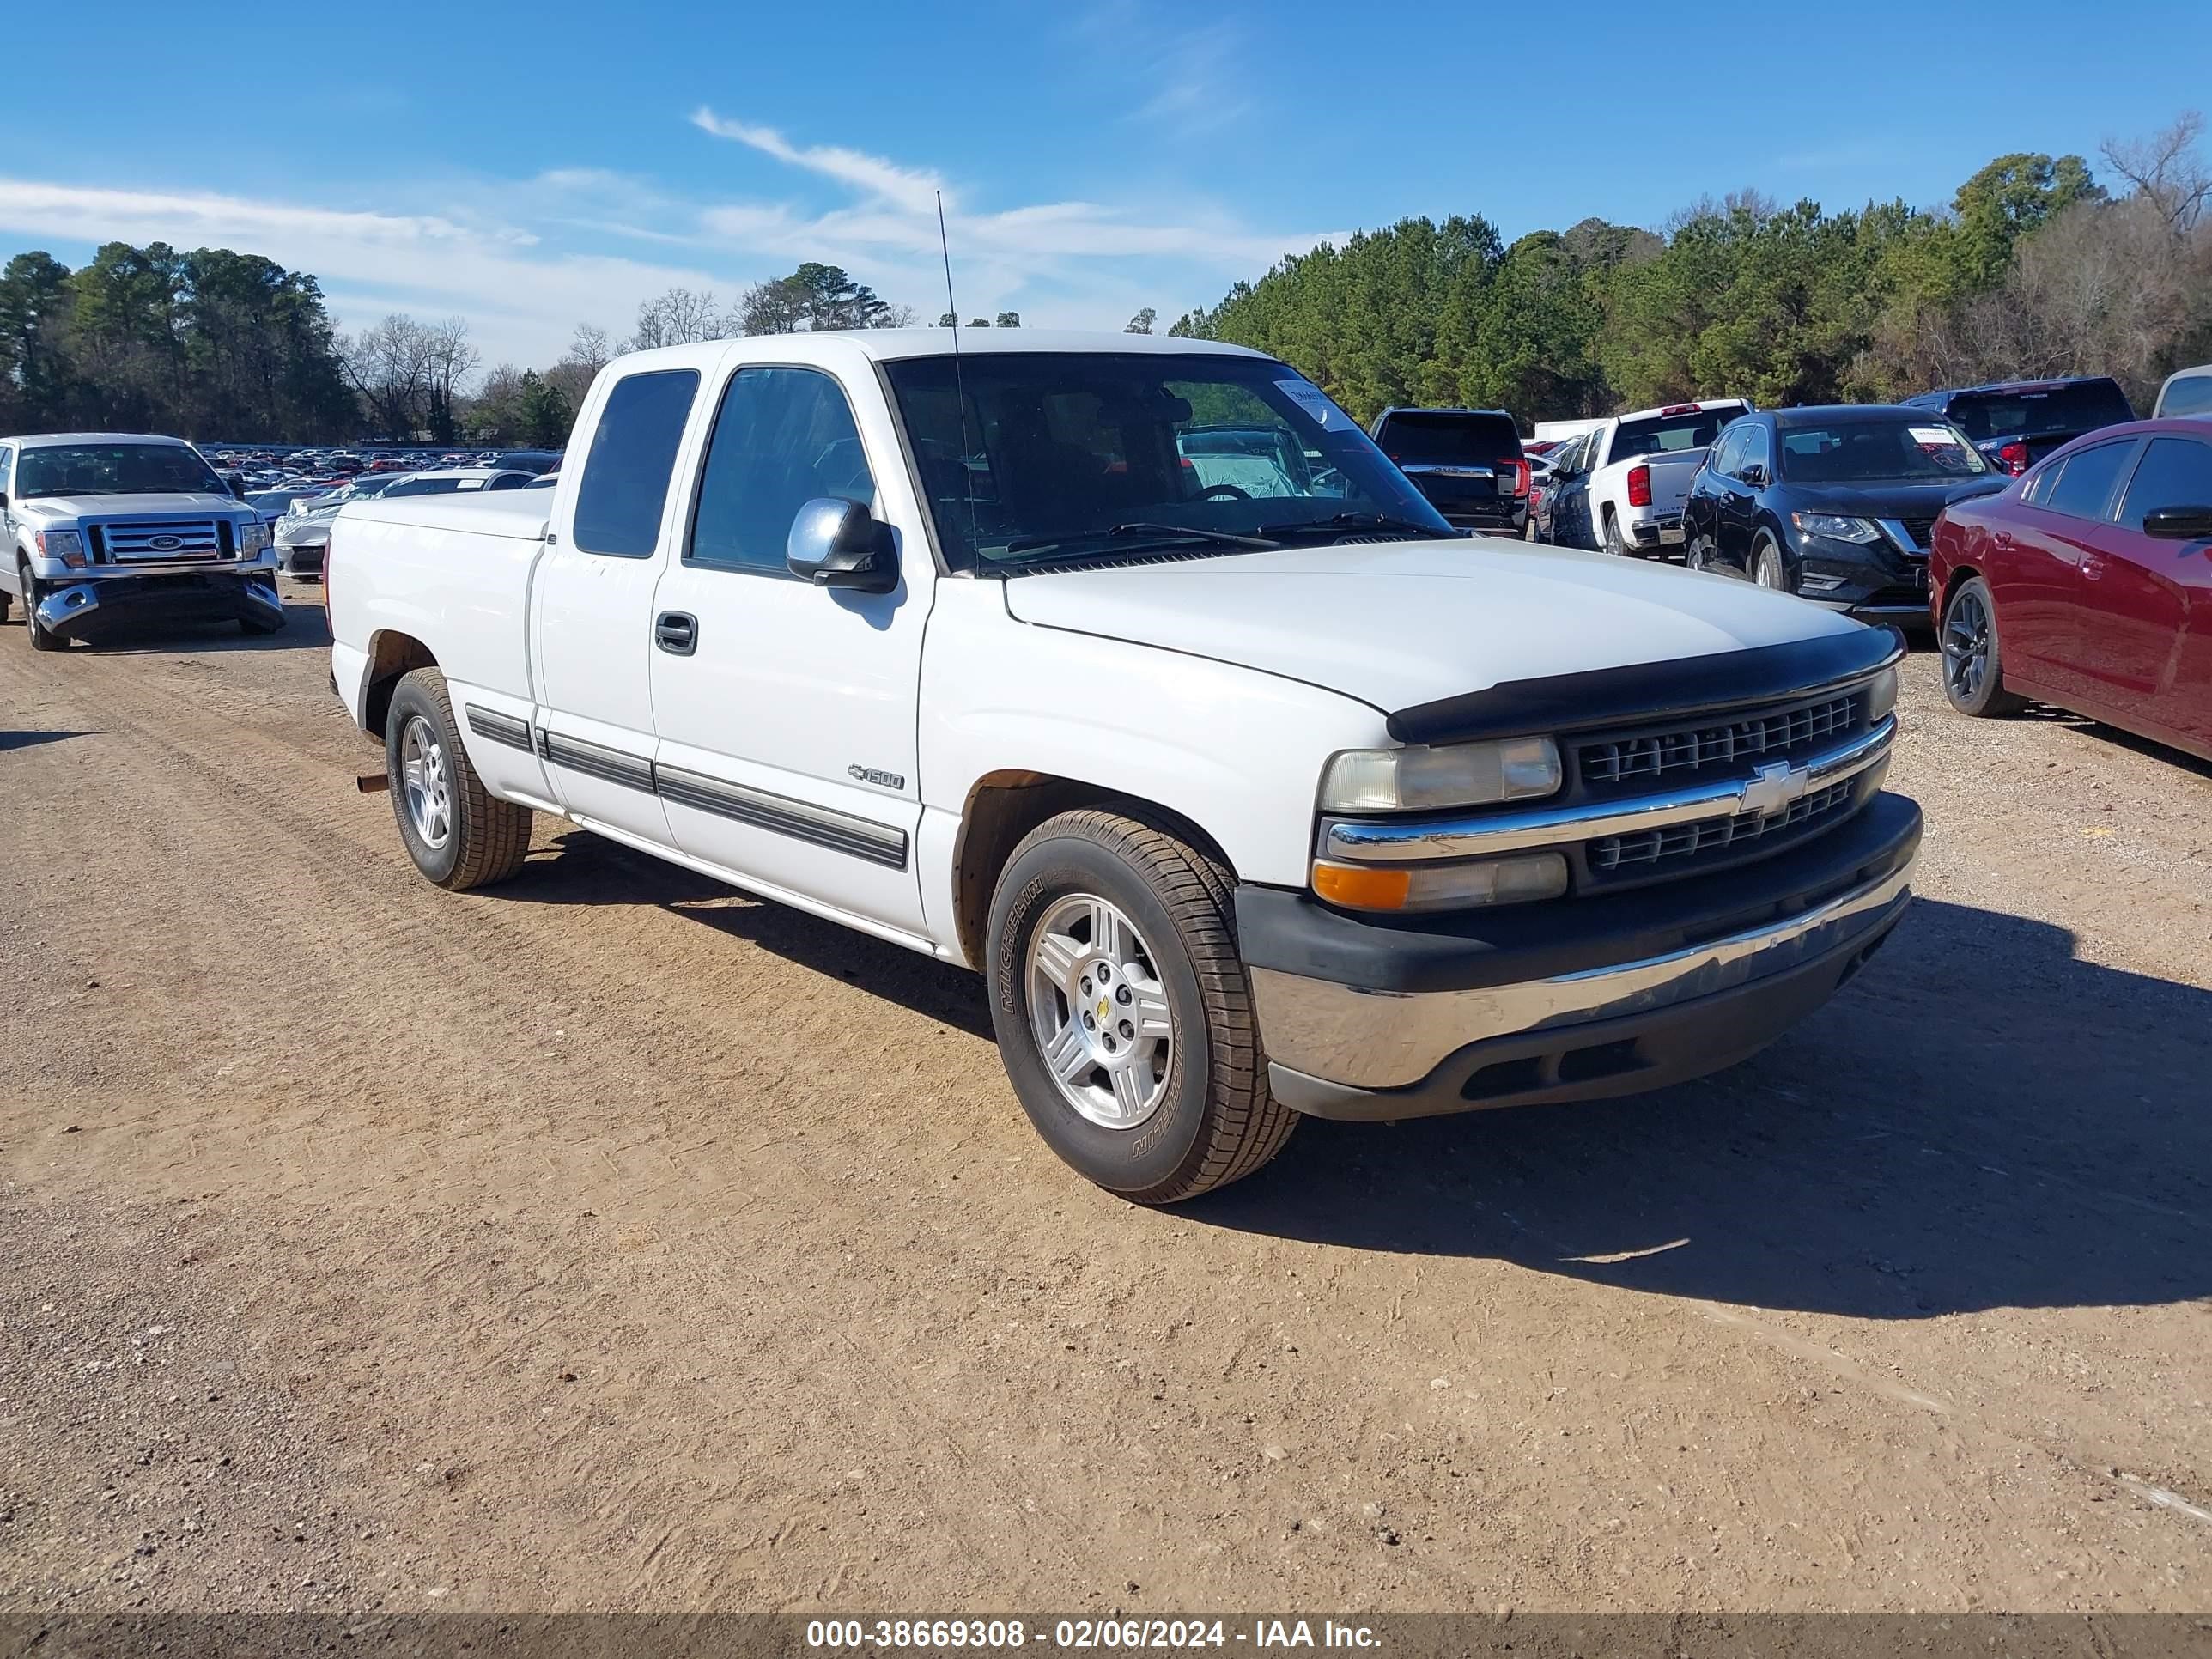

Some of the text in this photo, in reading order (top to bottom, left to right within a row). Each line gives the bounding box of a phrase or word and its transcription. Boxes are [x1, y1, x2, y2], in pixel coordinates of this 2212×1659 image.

[866, 768, 902, 789] 1500
[999, 874, 1046, 1015] MICHELIN
[1132, 1014, 1184, 1159] MICHELIN
